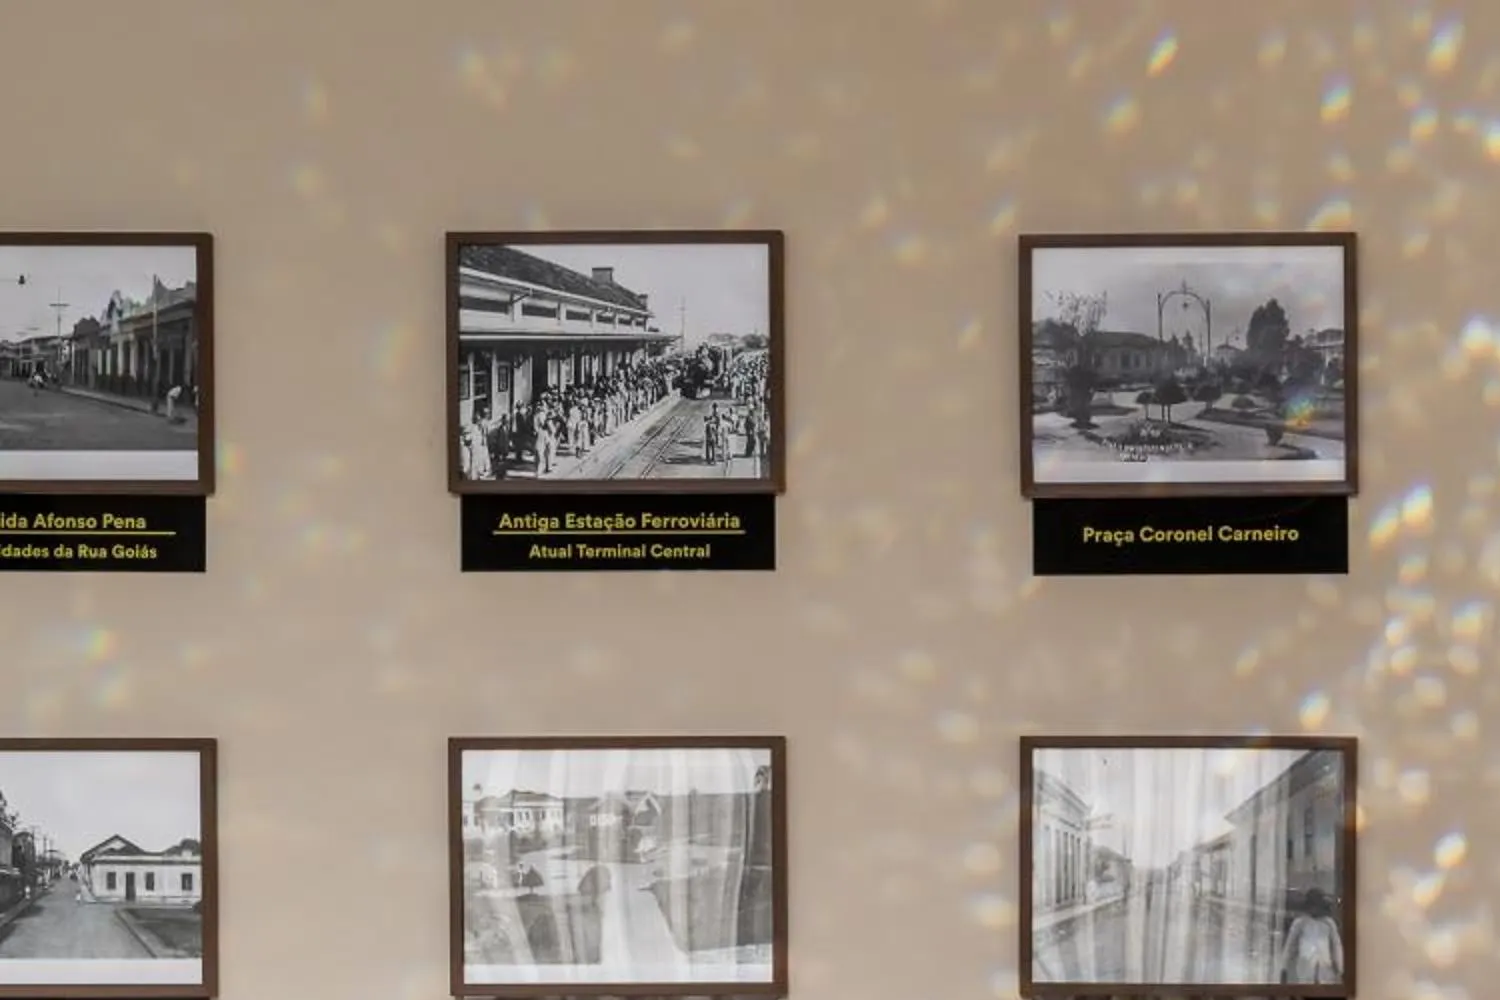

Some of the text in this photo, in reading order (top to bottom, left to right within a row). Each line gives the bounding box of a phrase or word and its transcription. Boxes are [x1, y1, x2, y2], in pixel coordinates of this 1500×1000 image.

[33, 513, 98, 529] Afonso
[102, 513, 147, 529] Pena
[499, 511, 741, 533] Antiga Estação Ferroviária
[1083, 524, 1300, 547] Praça Coronel Carneiro
[0, 543, 157, 559] dades da Rua Goiás
[529, 543, 711, 559] Atual Terminal Central
